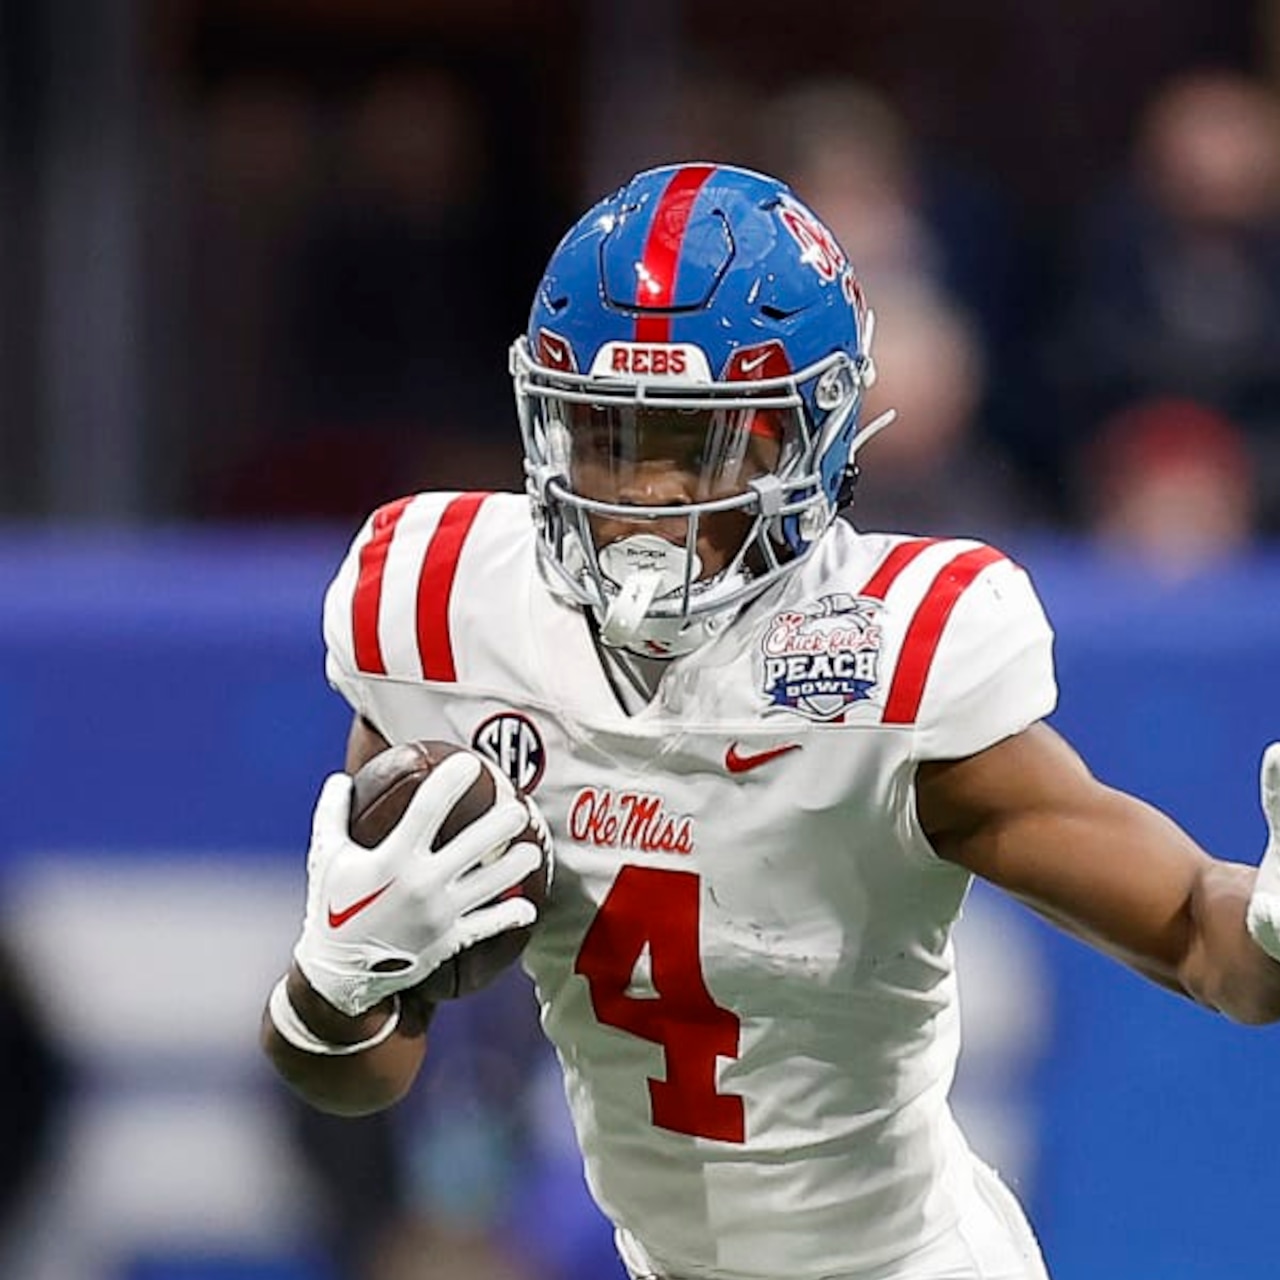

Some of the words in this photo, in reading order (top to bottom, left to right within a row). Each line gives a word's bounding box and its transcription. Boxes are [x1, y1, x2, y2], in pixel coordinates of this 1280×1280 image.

[611, 346, 686, 374] REBS
[764, 650, 878, 693] PEACH
[785, 681, 856, 697] BOWL
[477, 718, 538, 788] SEC
[570, 790, 617, 846] Ole
[621, 793, 694, 854] Miss
[574, 865, 746, 1144] 4
